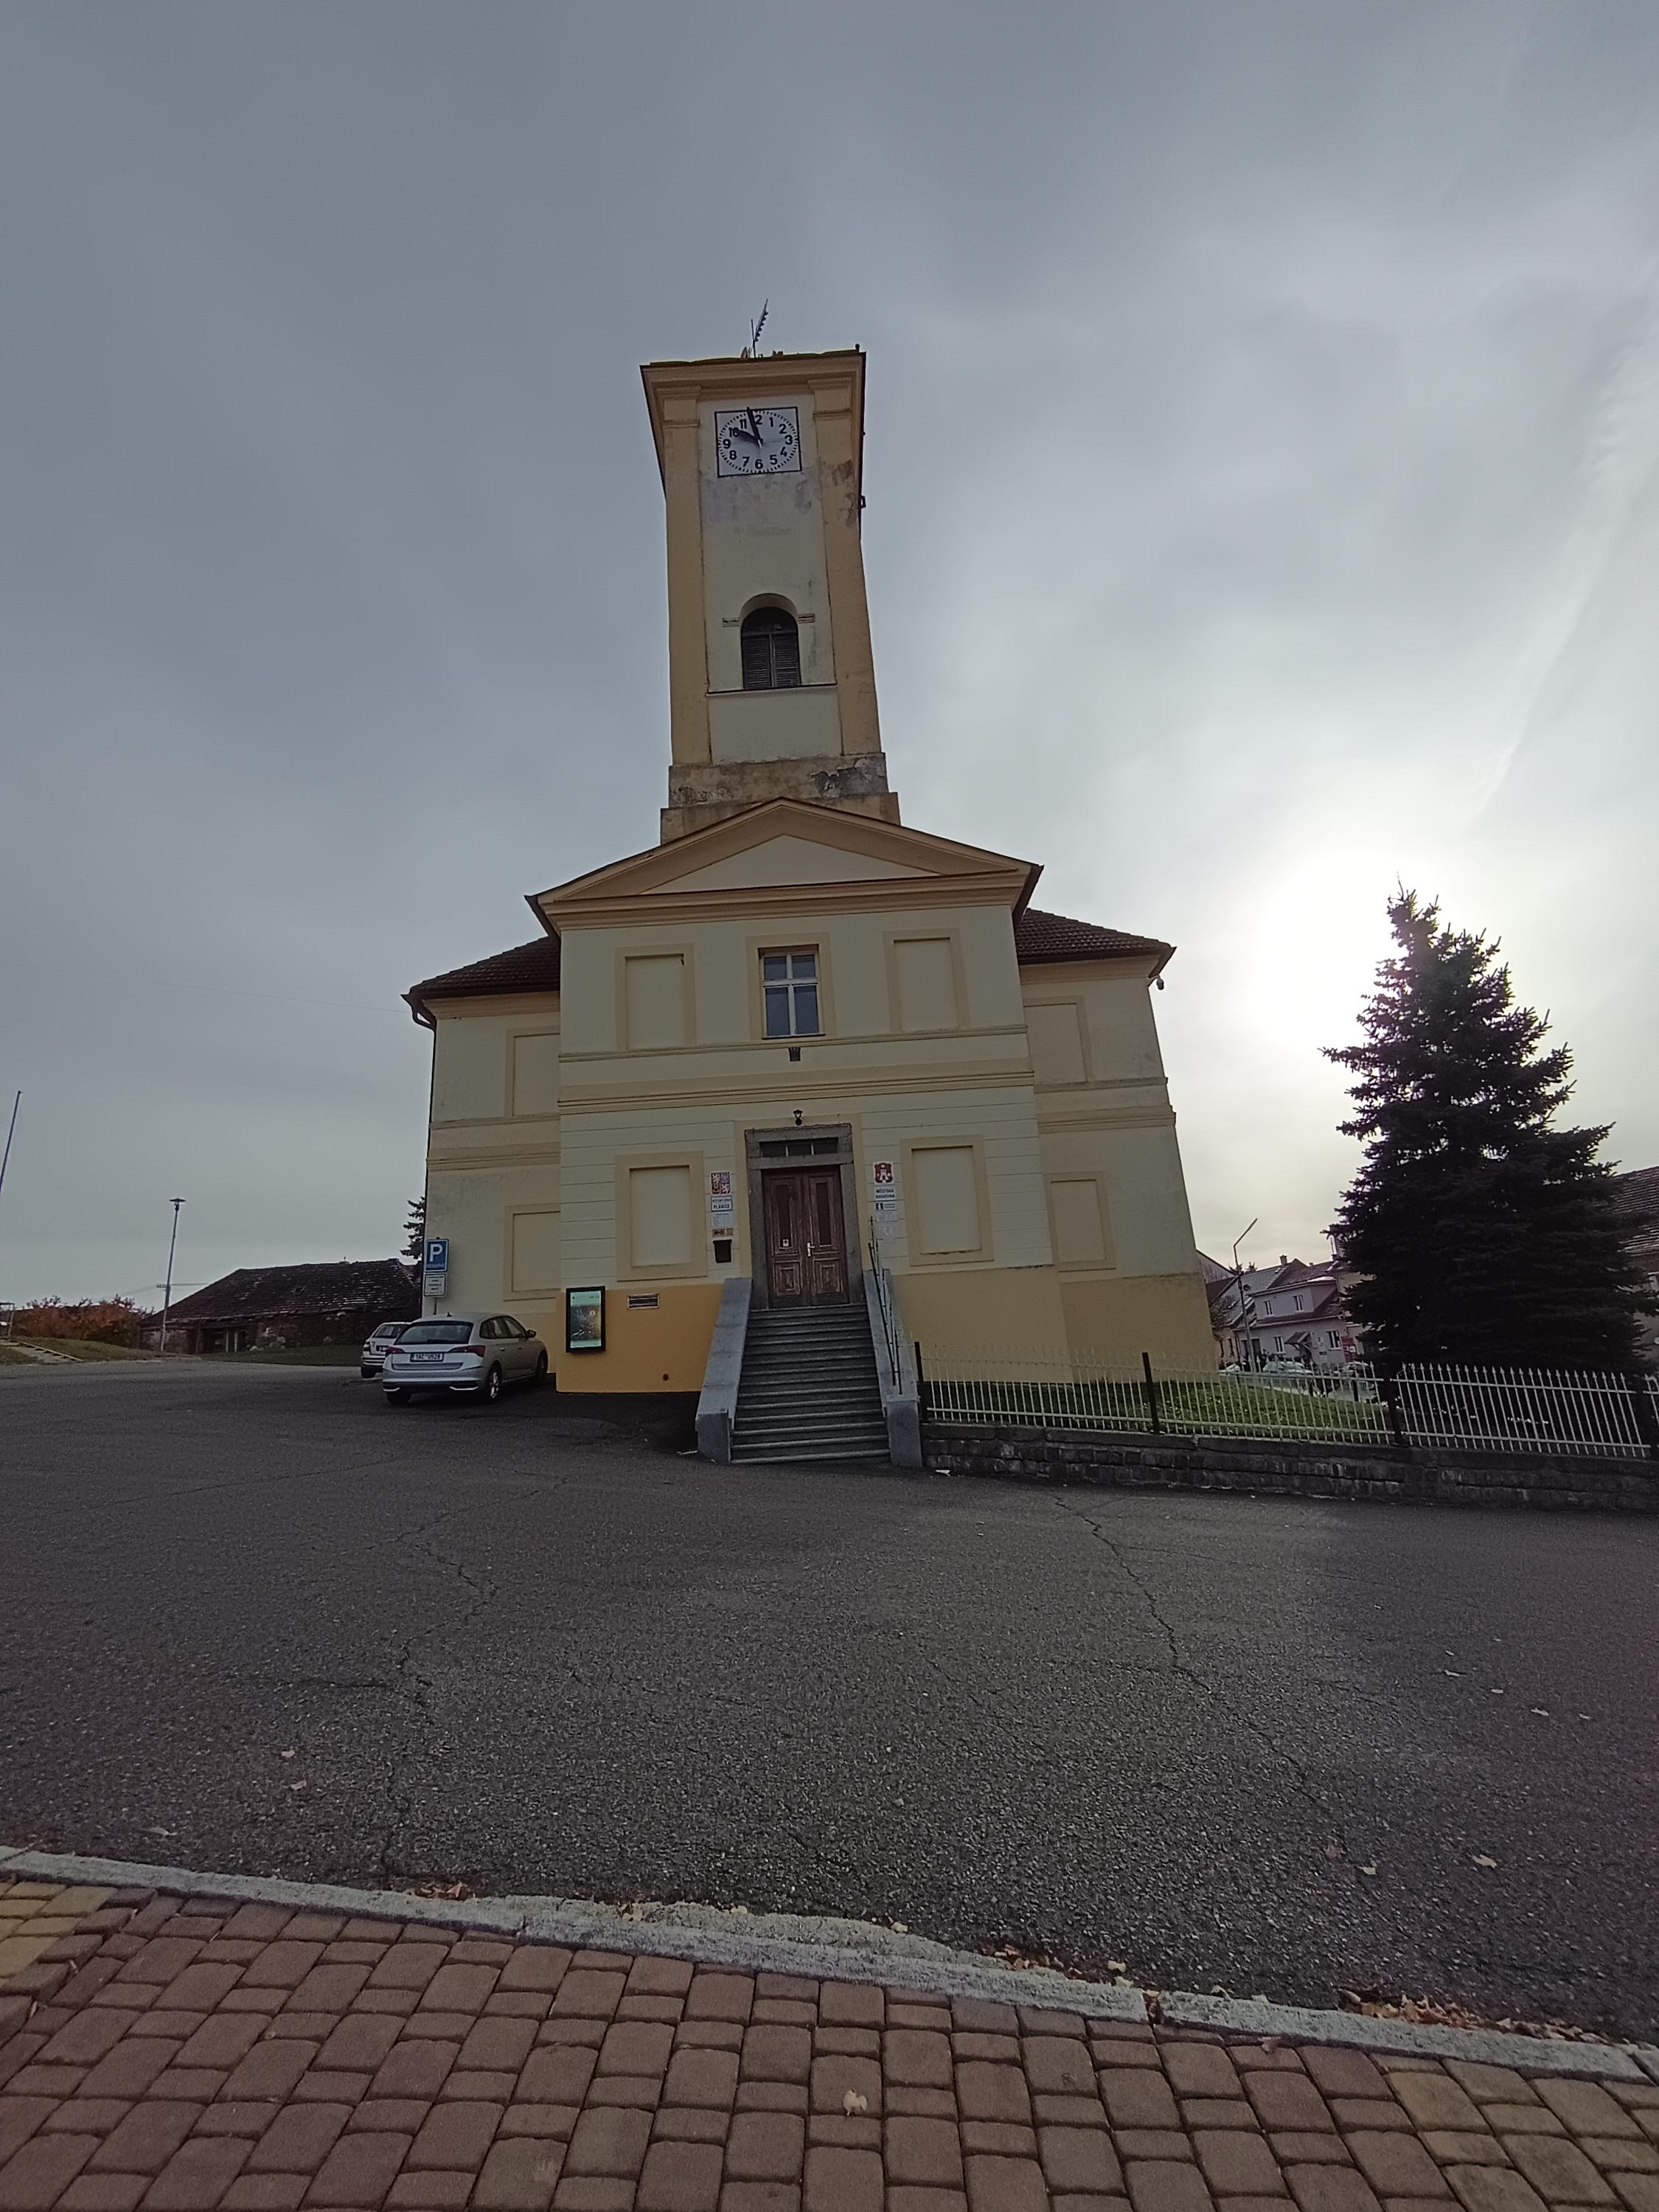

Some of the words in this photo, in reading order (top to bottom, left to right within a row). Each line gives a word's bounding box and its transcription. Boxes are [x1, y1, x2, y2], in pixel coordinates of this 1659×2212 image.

[740, 419, 747, 429] 11
[769, 417, 773, 427] 1
[728, 427, 740, 437] 10
[779, 424, 787, 434] 2
[723, 439, 731, 449] 9
[785, 435, 793, 445] 3
[729, 450, 737, 460] 8
[780, 446, 787, 457] 4
[742, 456, 750, 467] 7
[754, 459, 763, 470] 6
[769, 454, 778, 465] 5
[430, 1243, 443, 1262] P
